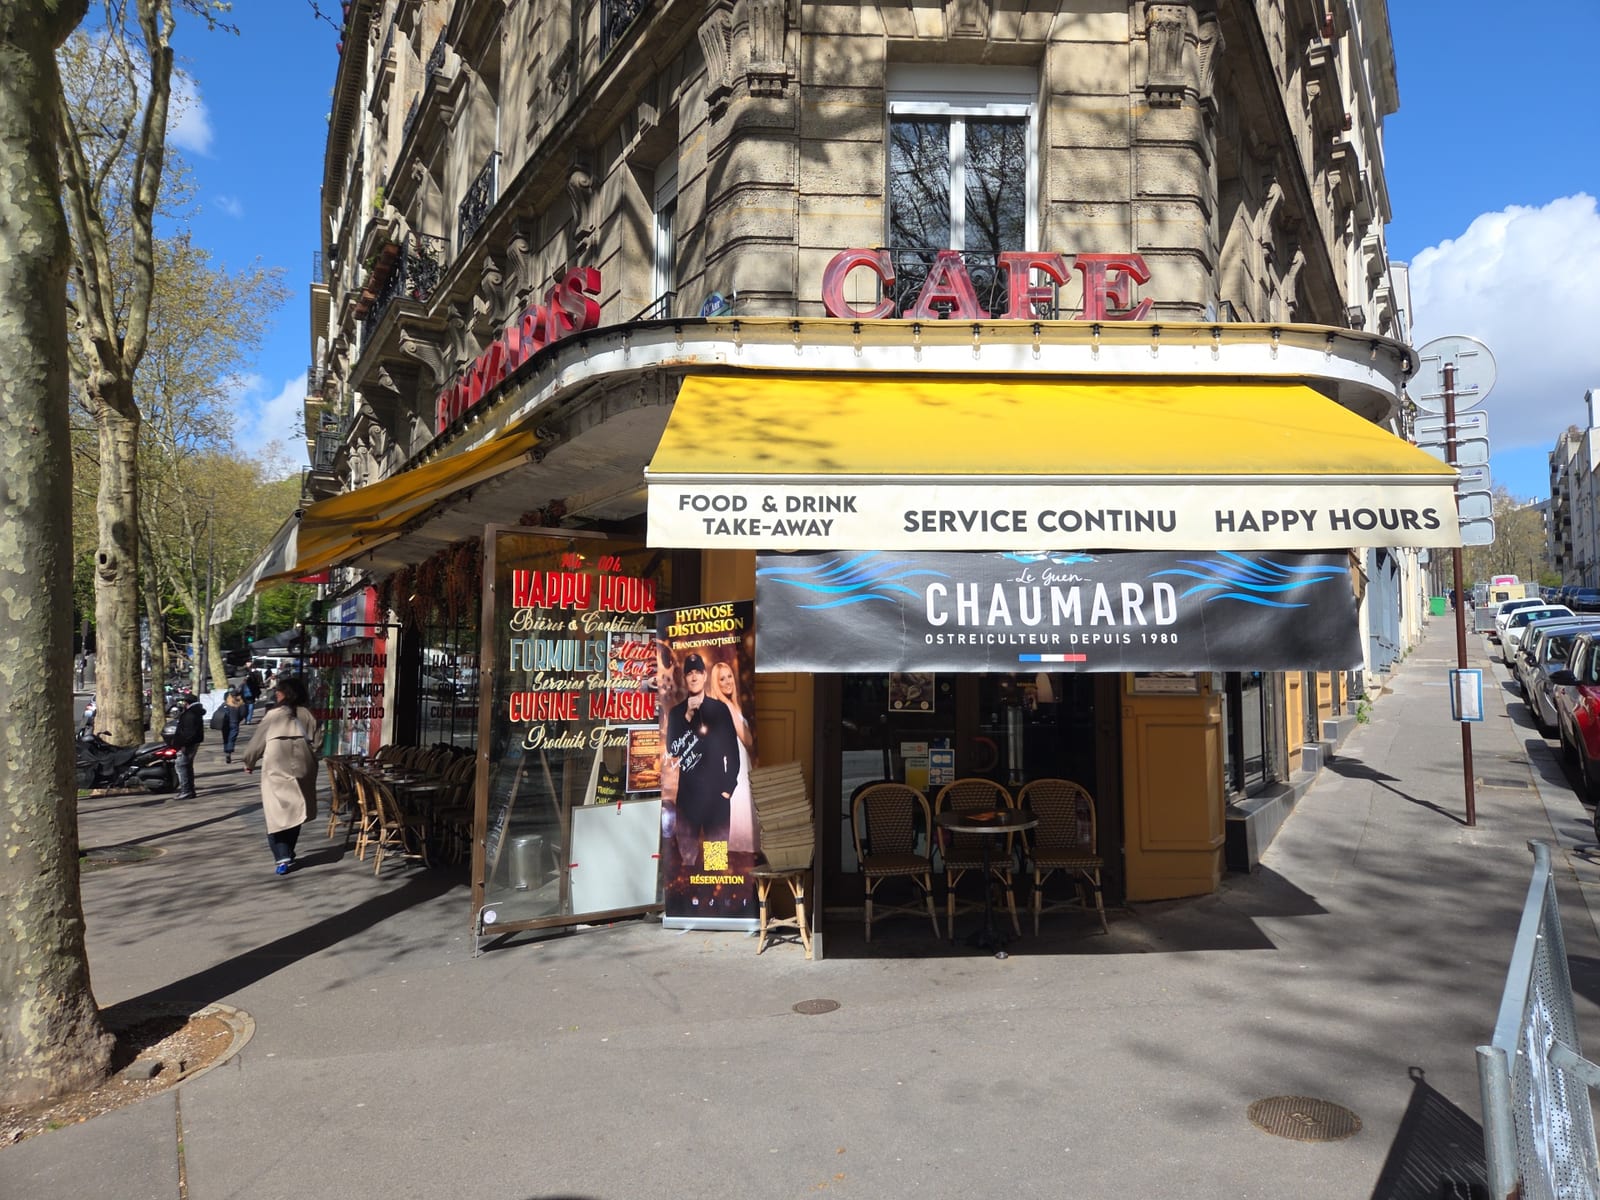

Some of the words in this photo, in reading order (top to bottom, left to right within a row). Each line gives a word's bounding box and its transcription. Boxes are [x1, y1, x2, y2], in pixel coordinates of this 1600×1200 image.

[822, 248, 1156, 320] CAFE
[680, 495, 747, 512] FOOD
[763, 495, 778, 513] &
[787, 495, 857, 513] DRINK
[703, 518, 834, 537] TAKE-AWAY
[904, 510, 1027, 533] SERVICE
[1038, 510, 1176, 533] CONTINU
[1216, 509, 1317, 532] HAPPY
[1329, 508, 1441, 531] HOURS
[1015, 567, 1036, 584] Le
[512, 569, 592, 611] HAPPY
[599, 575, 657, 614] HOUR
[675, 603, 735, 622] HYPNOSE
[926, 582, 1178, 627] CHAUMARD
[667, 617, 745, 638] DISTORSION
[925, 633, 1060, 645] OSTREICULTEUR
[1070, 633, 1131, 644] DEPUIS
[1141, 633, 1178, 644] 1980
[509, 638, 606, 672] FORMULES
[532, 672, 585, 692] Service
[509, 692, 581, 723] CUISINE
[588, 691, 656, 721] MAISON
[521, 723, 586, 750] Produits
[589, 725, 629, 751] Frai
[689, 873, 745, 885] RÉSERVATION
